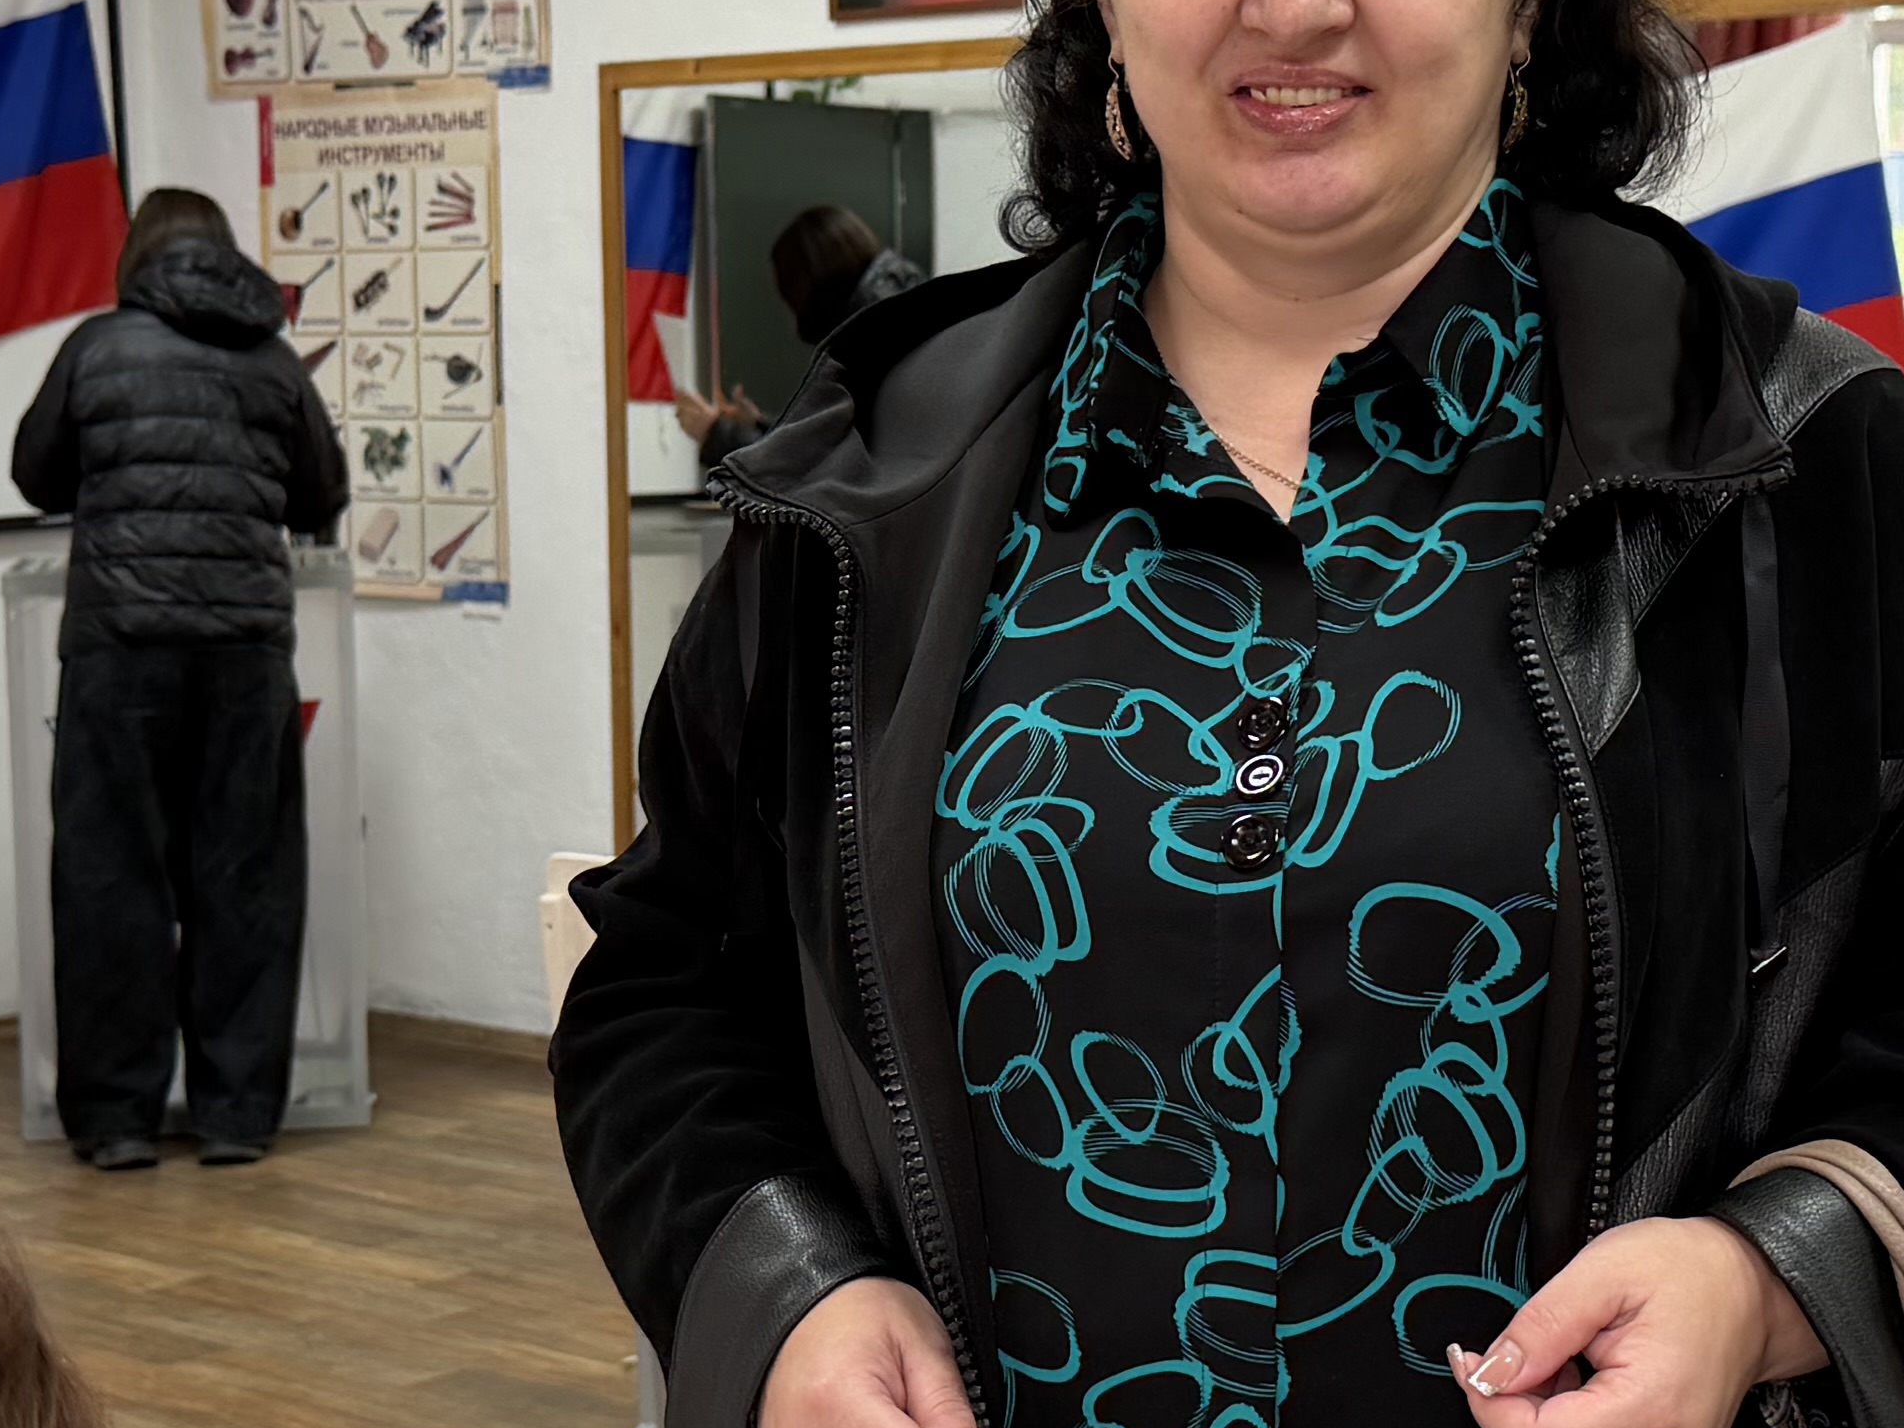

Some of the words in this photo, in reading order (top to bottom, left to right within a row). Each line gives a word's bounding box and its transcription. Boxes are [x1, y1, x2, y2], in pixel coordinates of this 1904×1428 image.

[274, 115, 361, 140] НАРОДНЫЕ
[363, 110, 488, 135] МУЗЫКАЛЬНЫЕ
[318, 142, 445, 166] ИНСТРУМЕНТЫ
